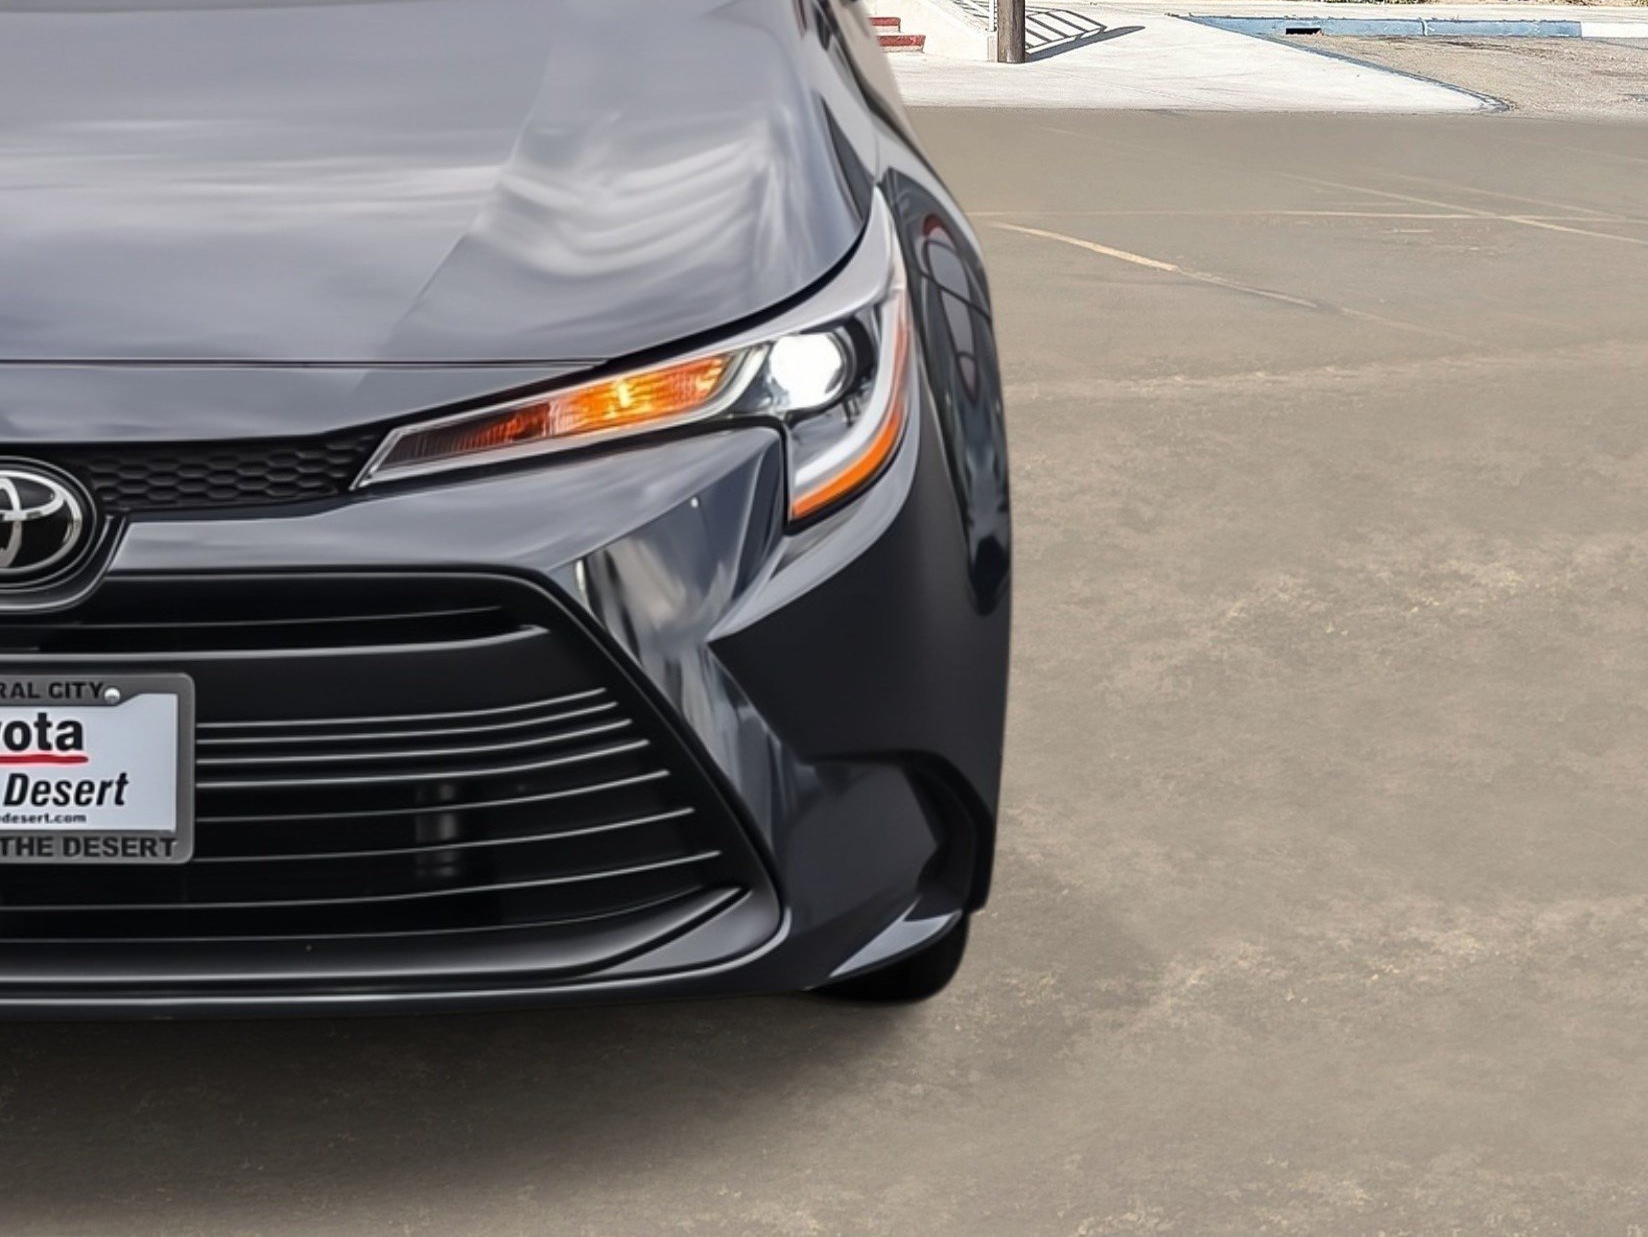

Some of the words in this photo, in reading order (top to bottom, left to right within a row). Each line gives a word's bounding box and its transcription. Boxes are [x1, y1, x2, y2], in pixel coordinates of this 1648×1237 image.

[48, 681, 104, 699] CITY
[2, 772, 129, 807] Desert
[63, 836, 177, 858] DESERT
